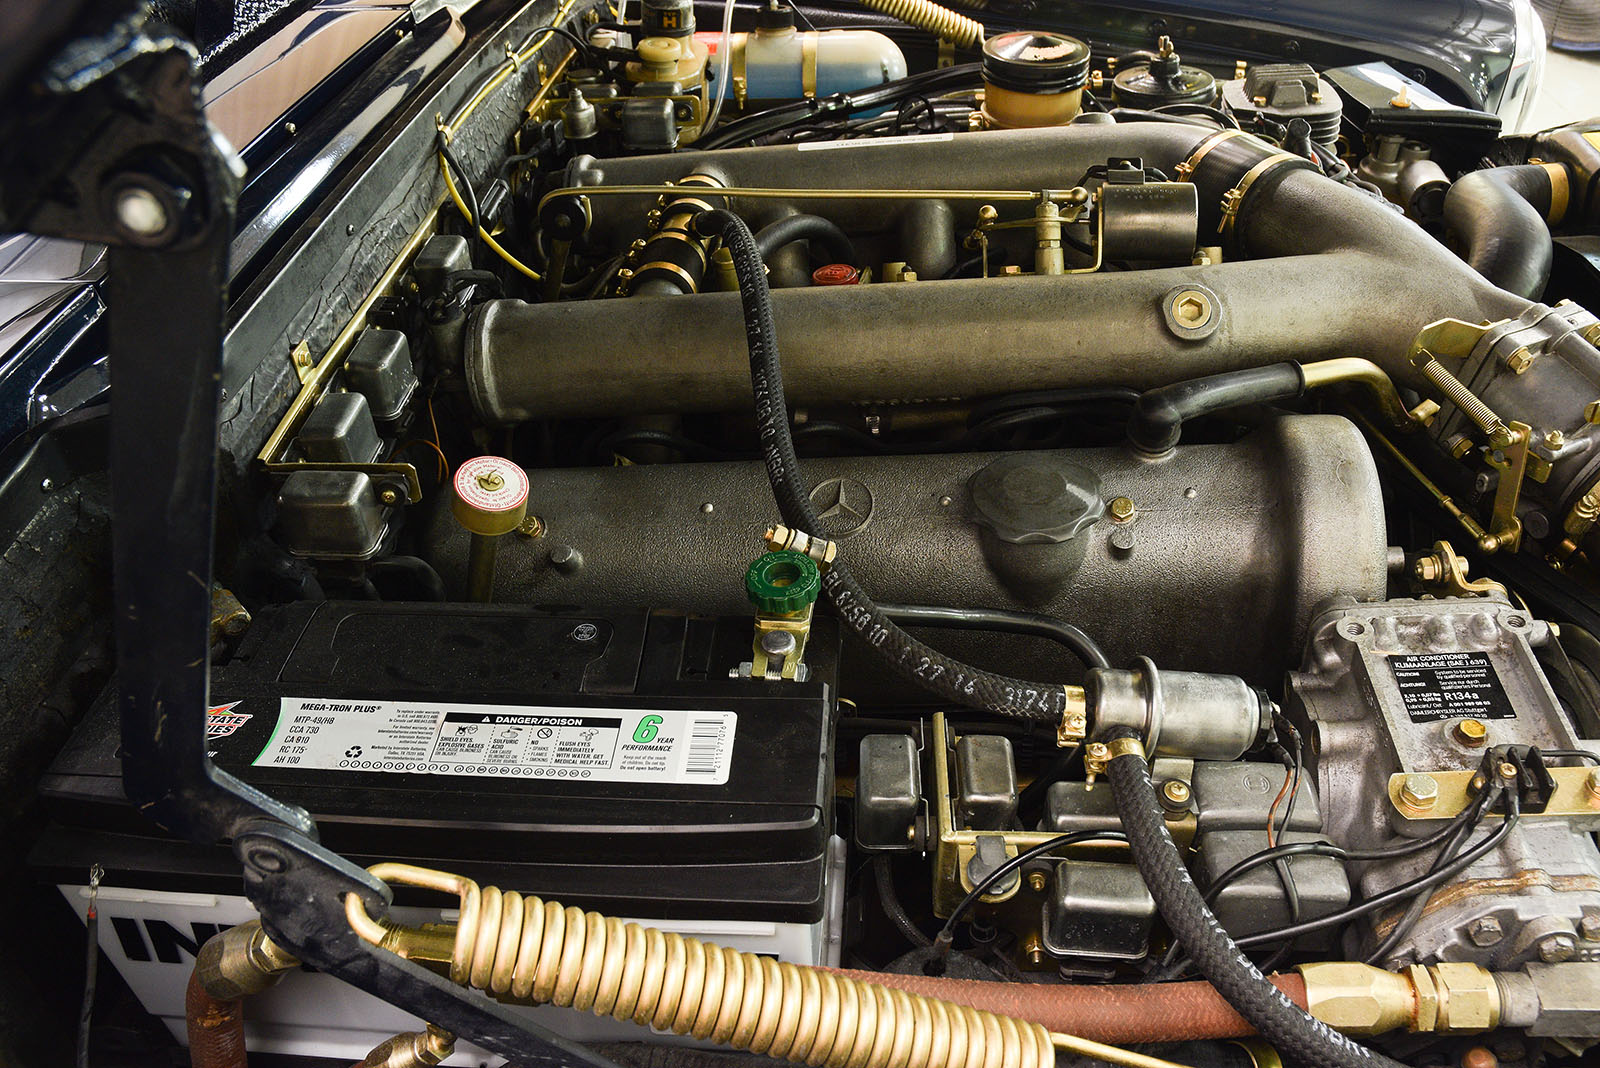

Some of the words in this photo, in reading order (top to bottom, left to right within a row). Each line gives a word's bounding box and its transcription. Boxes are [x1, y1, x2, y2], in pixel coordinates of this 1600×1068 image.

[1420, 653, 1470, 661] CONDITIONER
[1443, 691, 1480, 701] R134a
[300, 703, 351, 712] MEGA-TRON
[294, 715, 335, 724] MTP-49/H8
[495, 716, 583, 726] DANGER/POISON
[289, 725, 303, 733] CCA
[305, 726, 320, 734] 730
[632, 714, 664, 743] 6
[284, 735, 294, 743] CA
[295, 736, 310, 744] 910
[621, 744, 673, 752] PERFORMANCE
